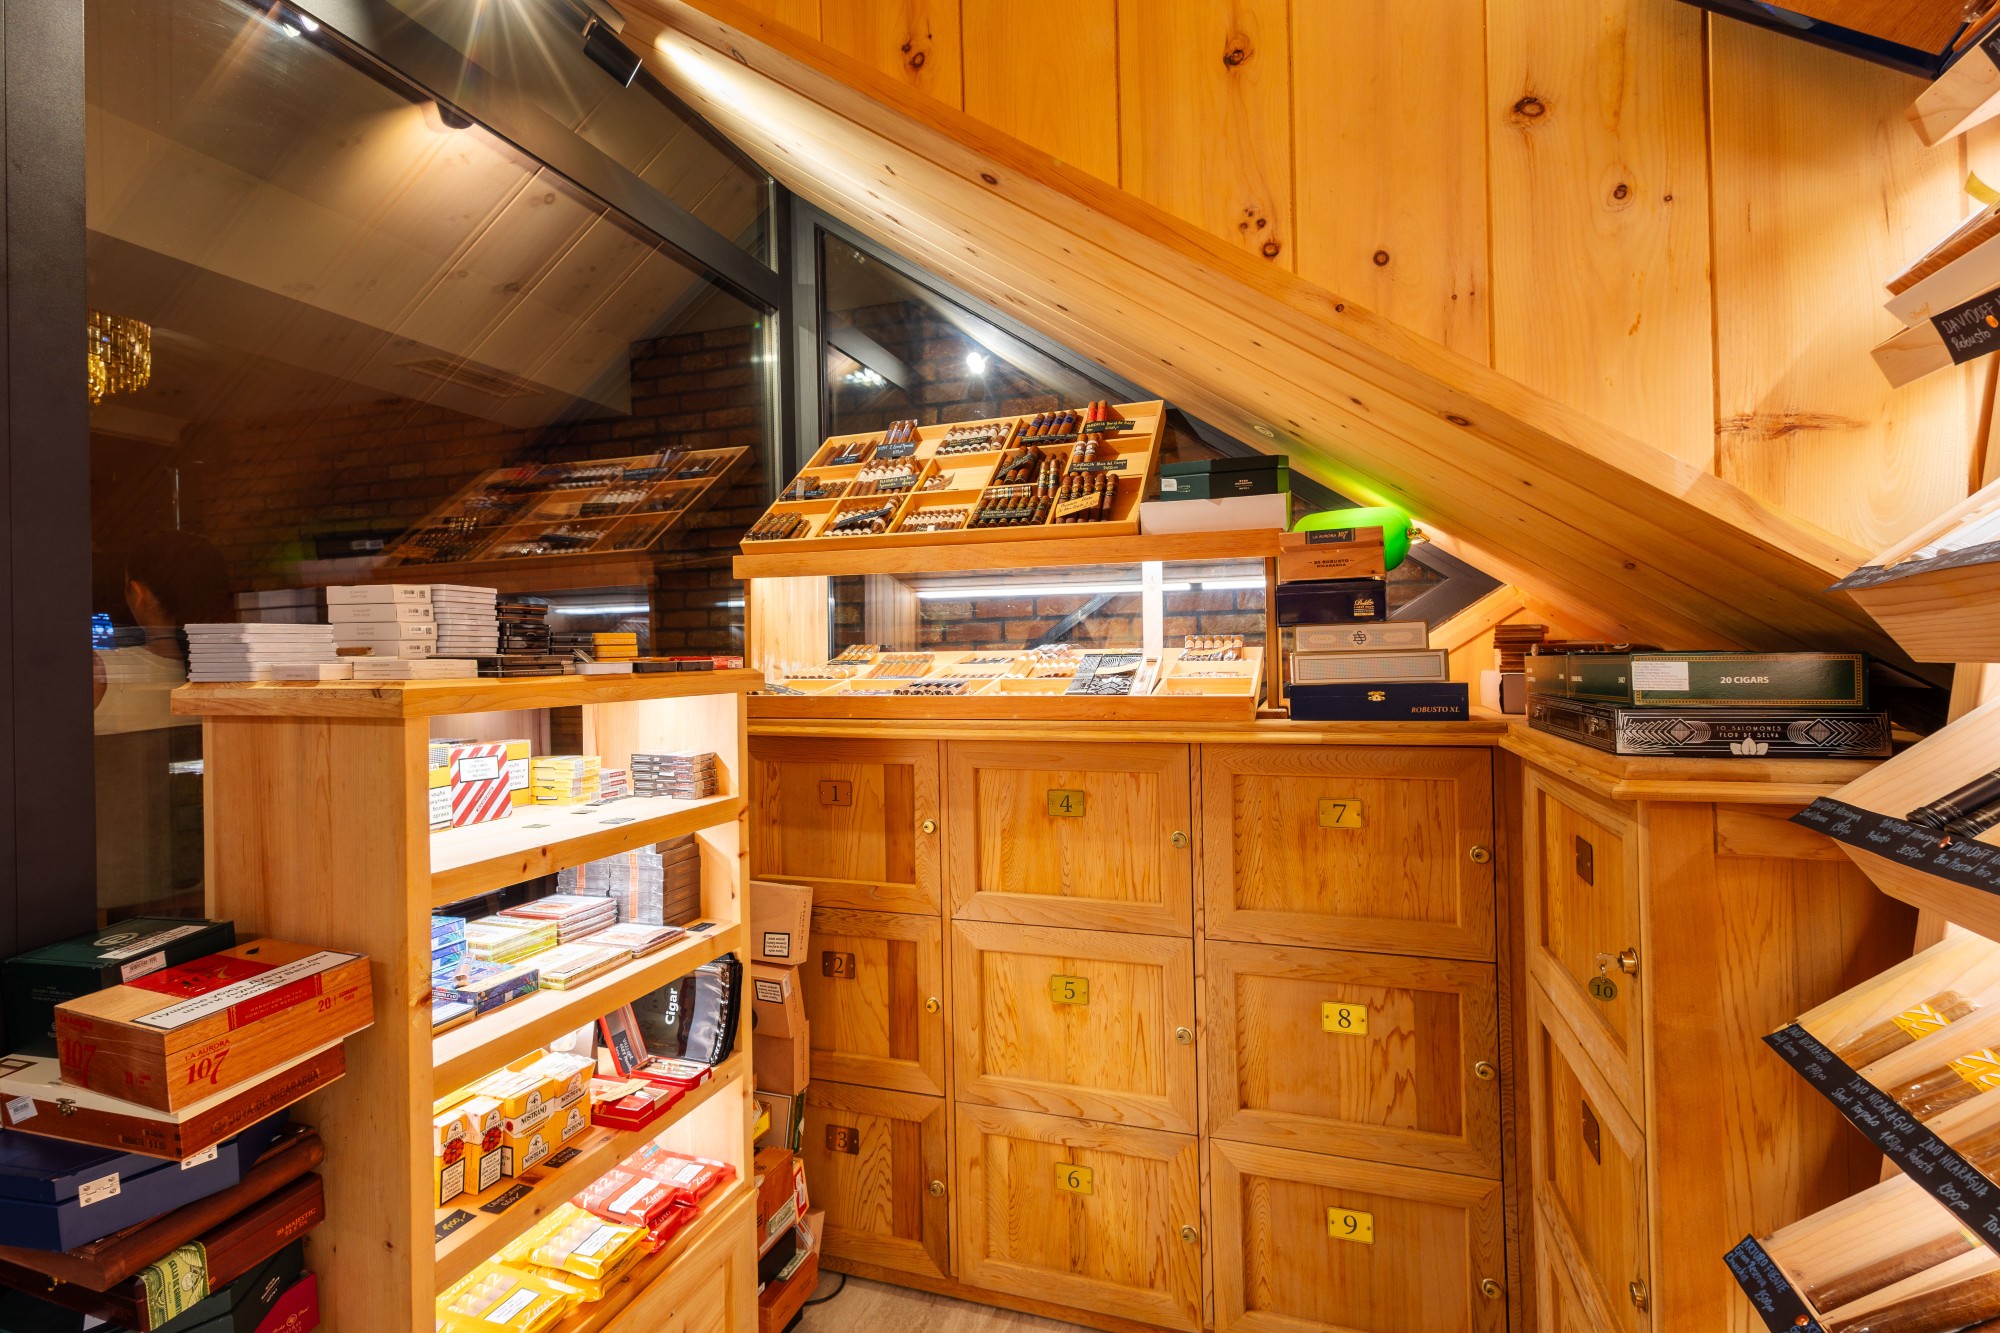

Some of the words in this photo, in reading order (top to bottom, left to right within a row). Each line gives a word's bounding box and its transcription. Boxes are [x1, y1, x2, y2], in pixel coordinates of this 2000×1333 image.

[1941, 302, 1993, 334] DAVIDOFF
[1951, 328, 1991, 351] Robusto
[1720, 676, 1732, 684] 20
[1734, 676, 1769, 684] CIGARS
[832, 786, 840, 801] 1
[1060, 795, 1072, 812] 4
[1333, 804, 1346, 823] 7
[1880, 819, 1913, 834] DAVIDOFF
[1948, 841, 1994, 858] DAVIDOFF
[247, 961, 304, 985] Дувански
[834, 957, 843, 973] 2
[1065, 981, 1075, 999] 5
[1595, 984, 1613, 998] 10
[318, 996, 332, 1012] 20
[665, 988, 679, 1025] Cigar
[68, 1016, 94, 1030] AURORA
[1338, 1008, 1351, 1028] 8
[184, 1051, 197, 1063] LA
[197, 1038, 230, 1057] AURORA
[62, 1038, 97, 1089] 107
[185, 1048, 230, 1086] 107
[229, 1103, 254, 1125] JOYA
[255, 1099, 268, 1111] DE
[269, 1068, 320, 1103] NICARAGUA
[521, 1104, 547, 1125] NOSTRANO
[1798, 1037, 1834, 1064] NICARAGUA
[1866, 1093, 1916, 1135] NICARAGUA
[1938, 1153, 1989, 1198] NICARAGUA
[564, 1120, 584, 1136] NOSTRANO
[1832, 1087, 1854, 1105] Short
[1850, 1101, 1880, 1127] Torpedo
[1904, 1148, 1935, 1175] Robusto
[838, 1132, 847, 1148] 3
[524, 1146, 547, 1163] NOSTRANO
[693, 1171, 712, 1187] Zino
[1068, 1171, 1079, 1188] 6
[642, 1189, 664, 1207] Zino
[286, 1207, 316, 1230] MAJESTIC
[653, 1210, 672, 1227] Zino
[1343, 1215, 1357, 1234] 9
[1734, 1245, 1750, 1264] Gran
[168, 1260, 176, 1279] SELLO
[1742, 1238, 1768, 1267] ARTURO
[1763, 1265, 1790, 1294] FUENTE
[522, 1299, 551, 1323] Zino
